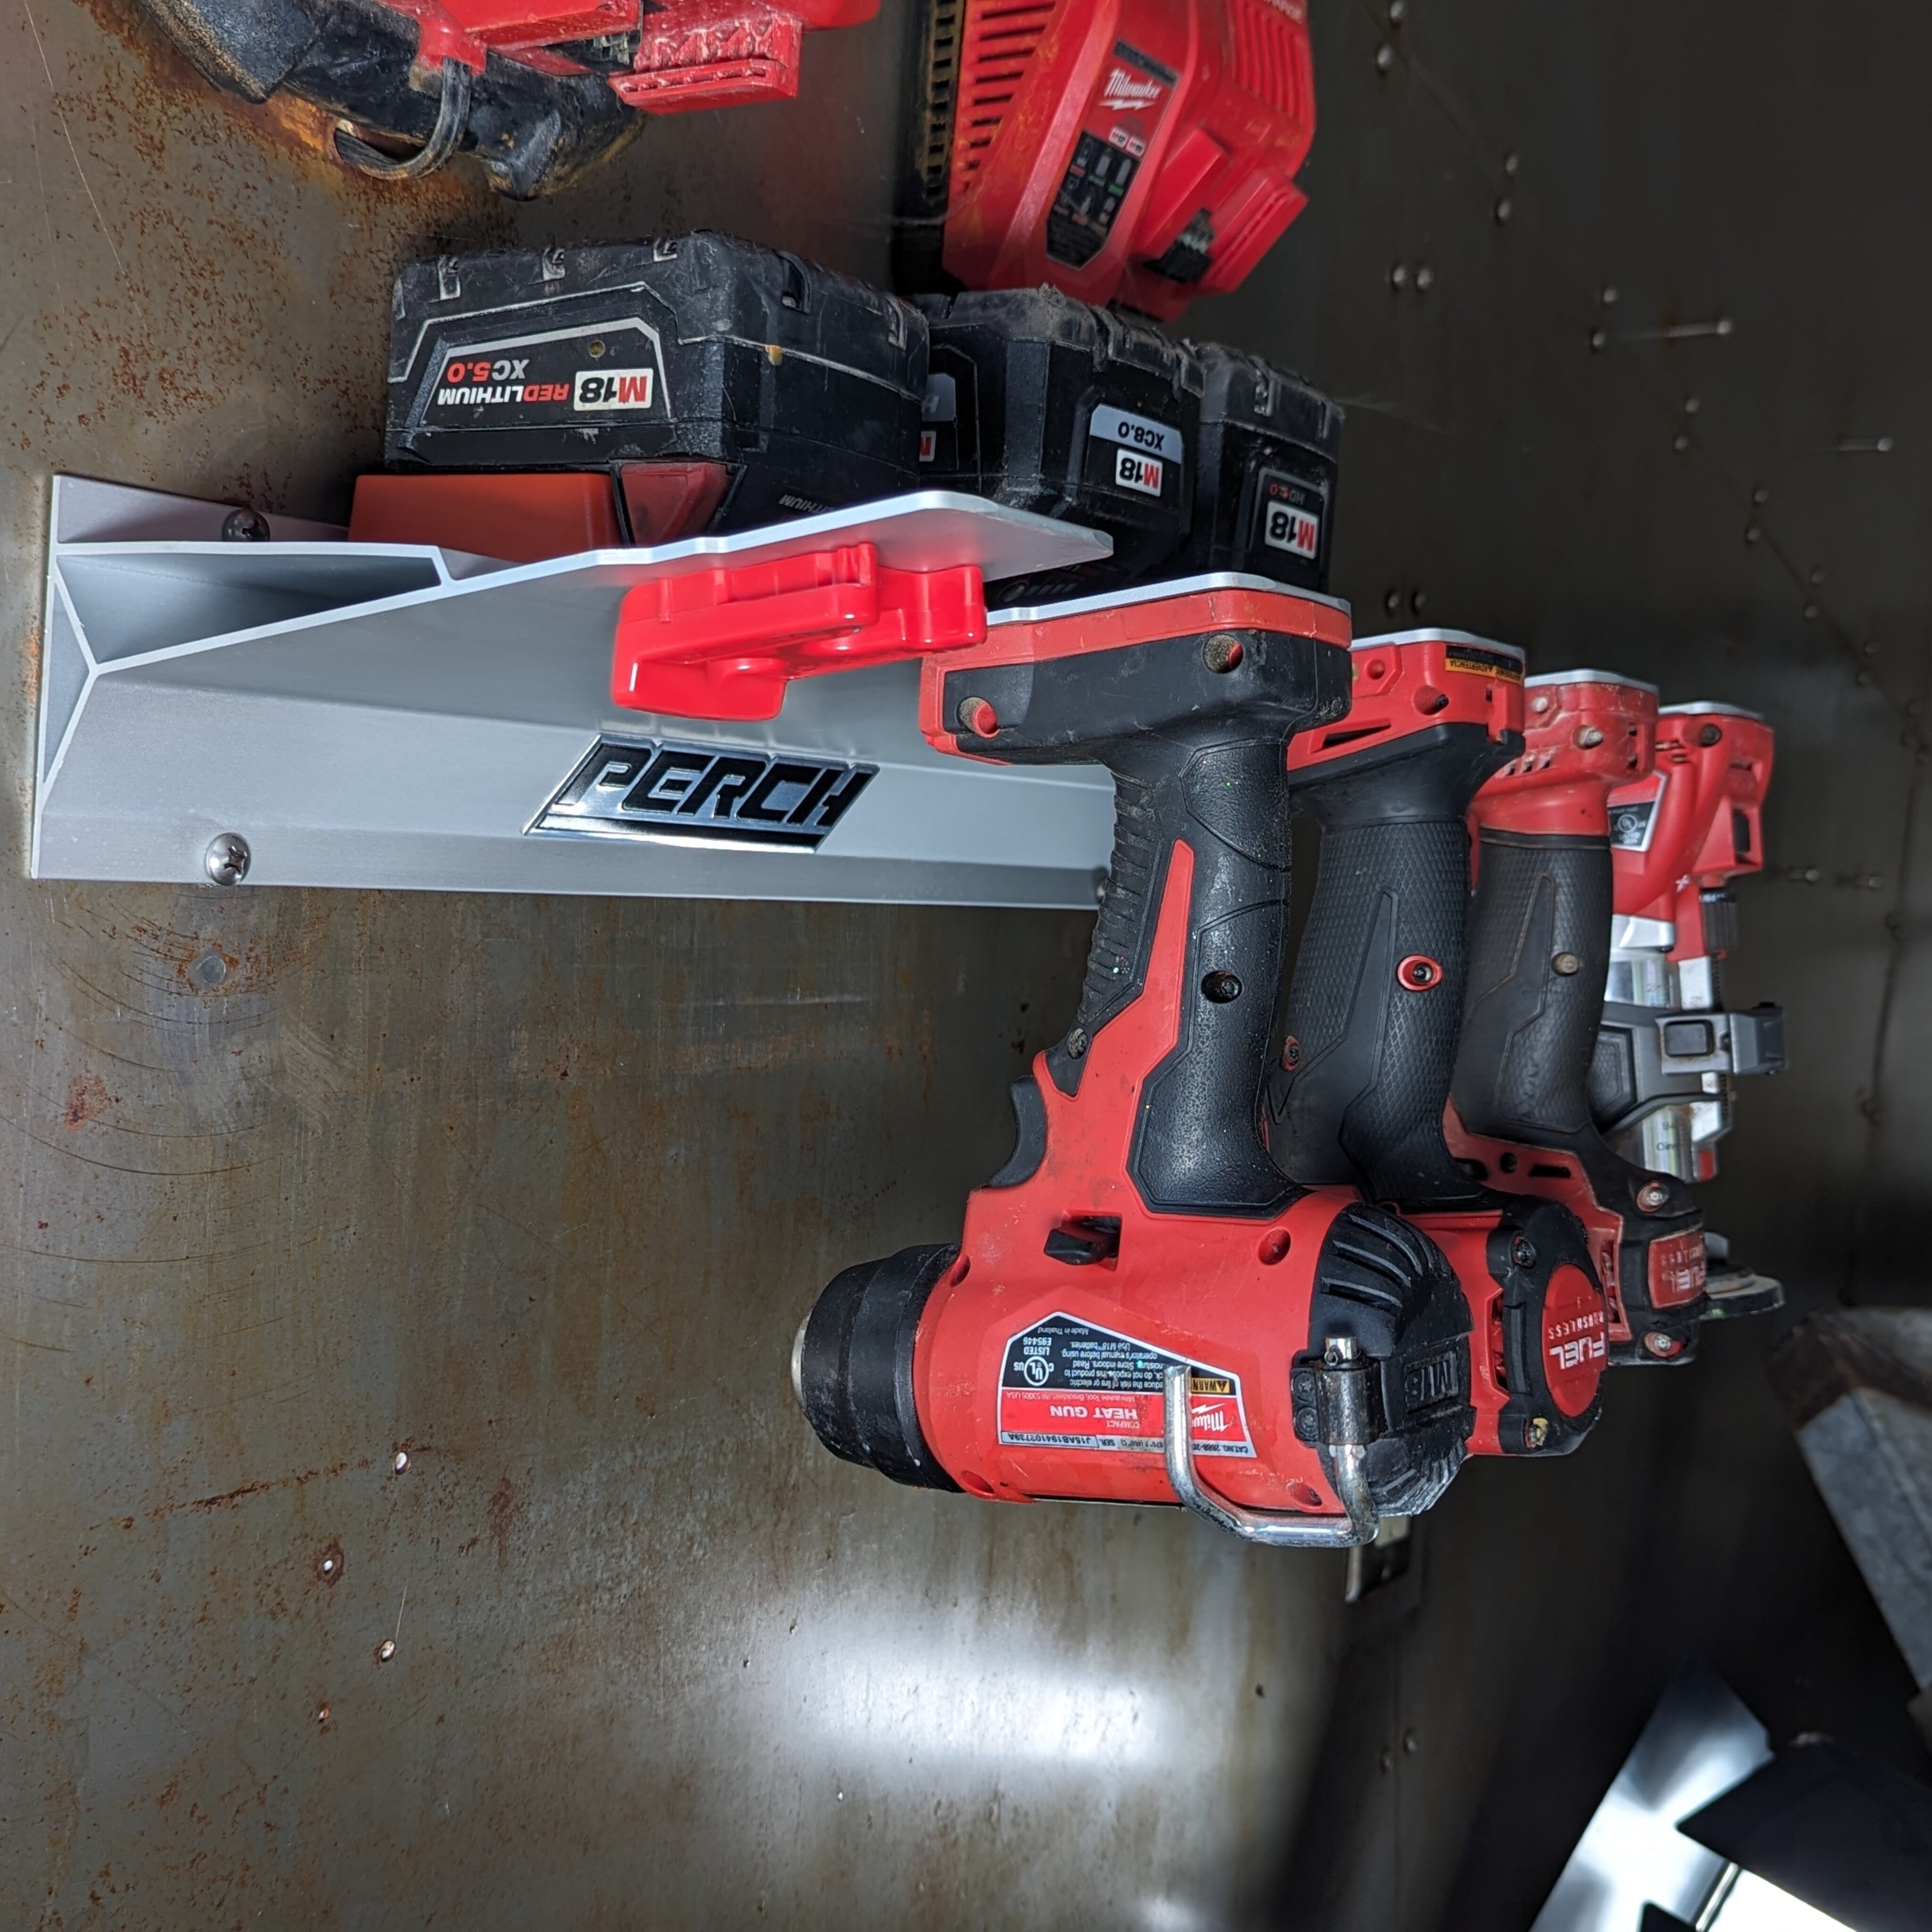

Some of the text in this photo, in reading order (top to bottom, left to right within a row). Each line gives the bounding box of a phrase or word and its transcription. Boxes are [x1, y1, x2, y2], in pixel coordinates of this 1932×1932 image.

[446, 359, 530, 383] XC5.0
[438, 376, 648, 405] M18 REDLITHIUM
[1117, 422, 1165, 451] XC8.0
[1119, 458, 1159, 489] M18
[1269, 511, 1315, 551] M18
[553, 742, 876, 827] PERCH
[1548, 1310, 1604, 1340] BRUSHLESS
[1037, 1327, 1064, 1335] Thailand
[1070, 1327, 1089, 1335] Made
[1023, 1337, 1052, 1346] E95446
[1023, 1346, 1050, 1356] LISTED
[1117, 1342, 1131, 1352] Use
[1549, 1332, 1605, 1369] FUEL
[1080, 1351, 1100, 1360] before
[1126, 1351, 1158, 1361] operator's
[1073, 1360, 1090, 1369] Read
[1116, 1361, 1134, 1371] Store
[1064, 1369, 1071, 1378] to
[1071, 1369, 1095, 1378] product
[1133, 1372, 1143, 1380] not
[1144, 1372, 1153, 1380] do
[1069, 1379, 1092, 1387] electric
[1112, 1380, 1119, 1389] of
[1119, 1381, 1132, 1389] risk
[1133, 1381, 1143, 1389] the
[1144, 1381, 1164, 1390] educe
[1191, 1379, 1217, 1392] WARN
[1049, 1405, 1138, 1420] HEAT GUN
[1106, 1420, 1141, 1429] COMPACT
